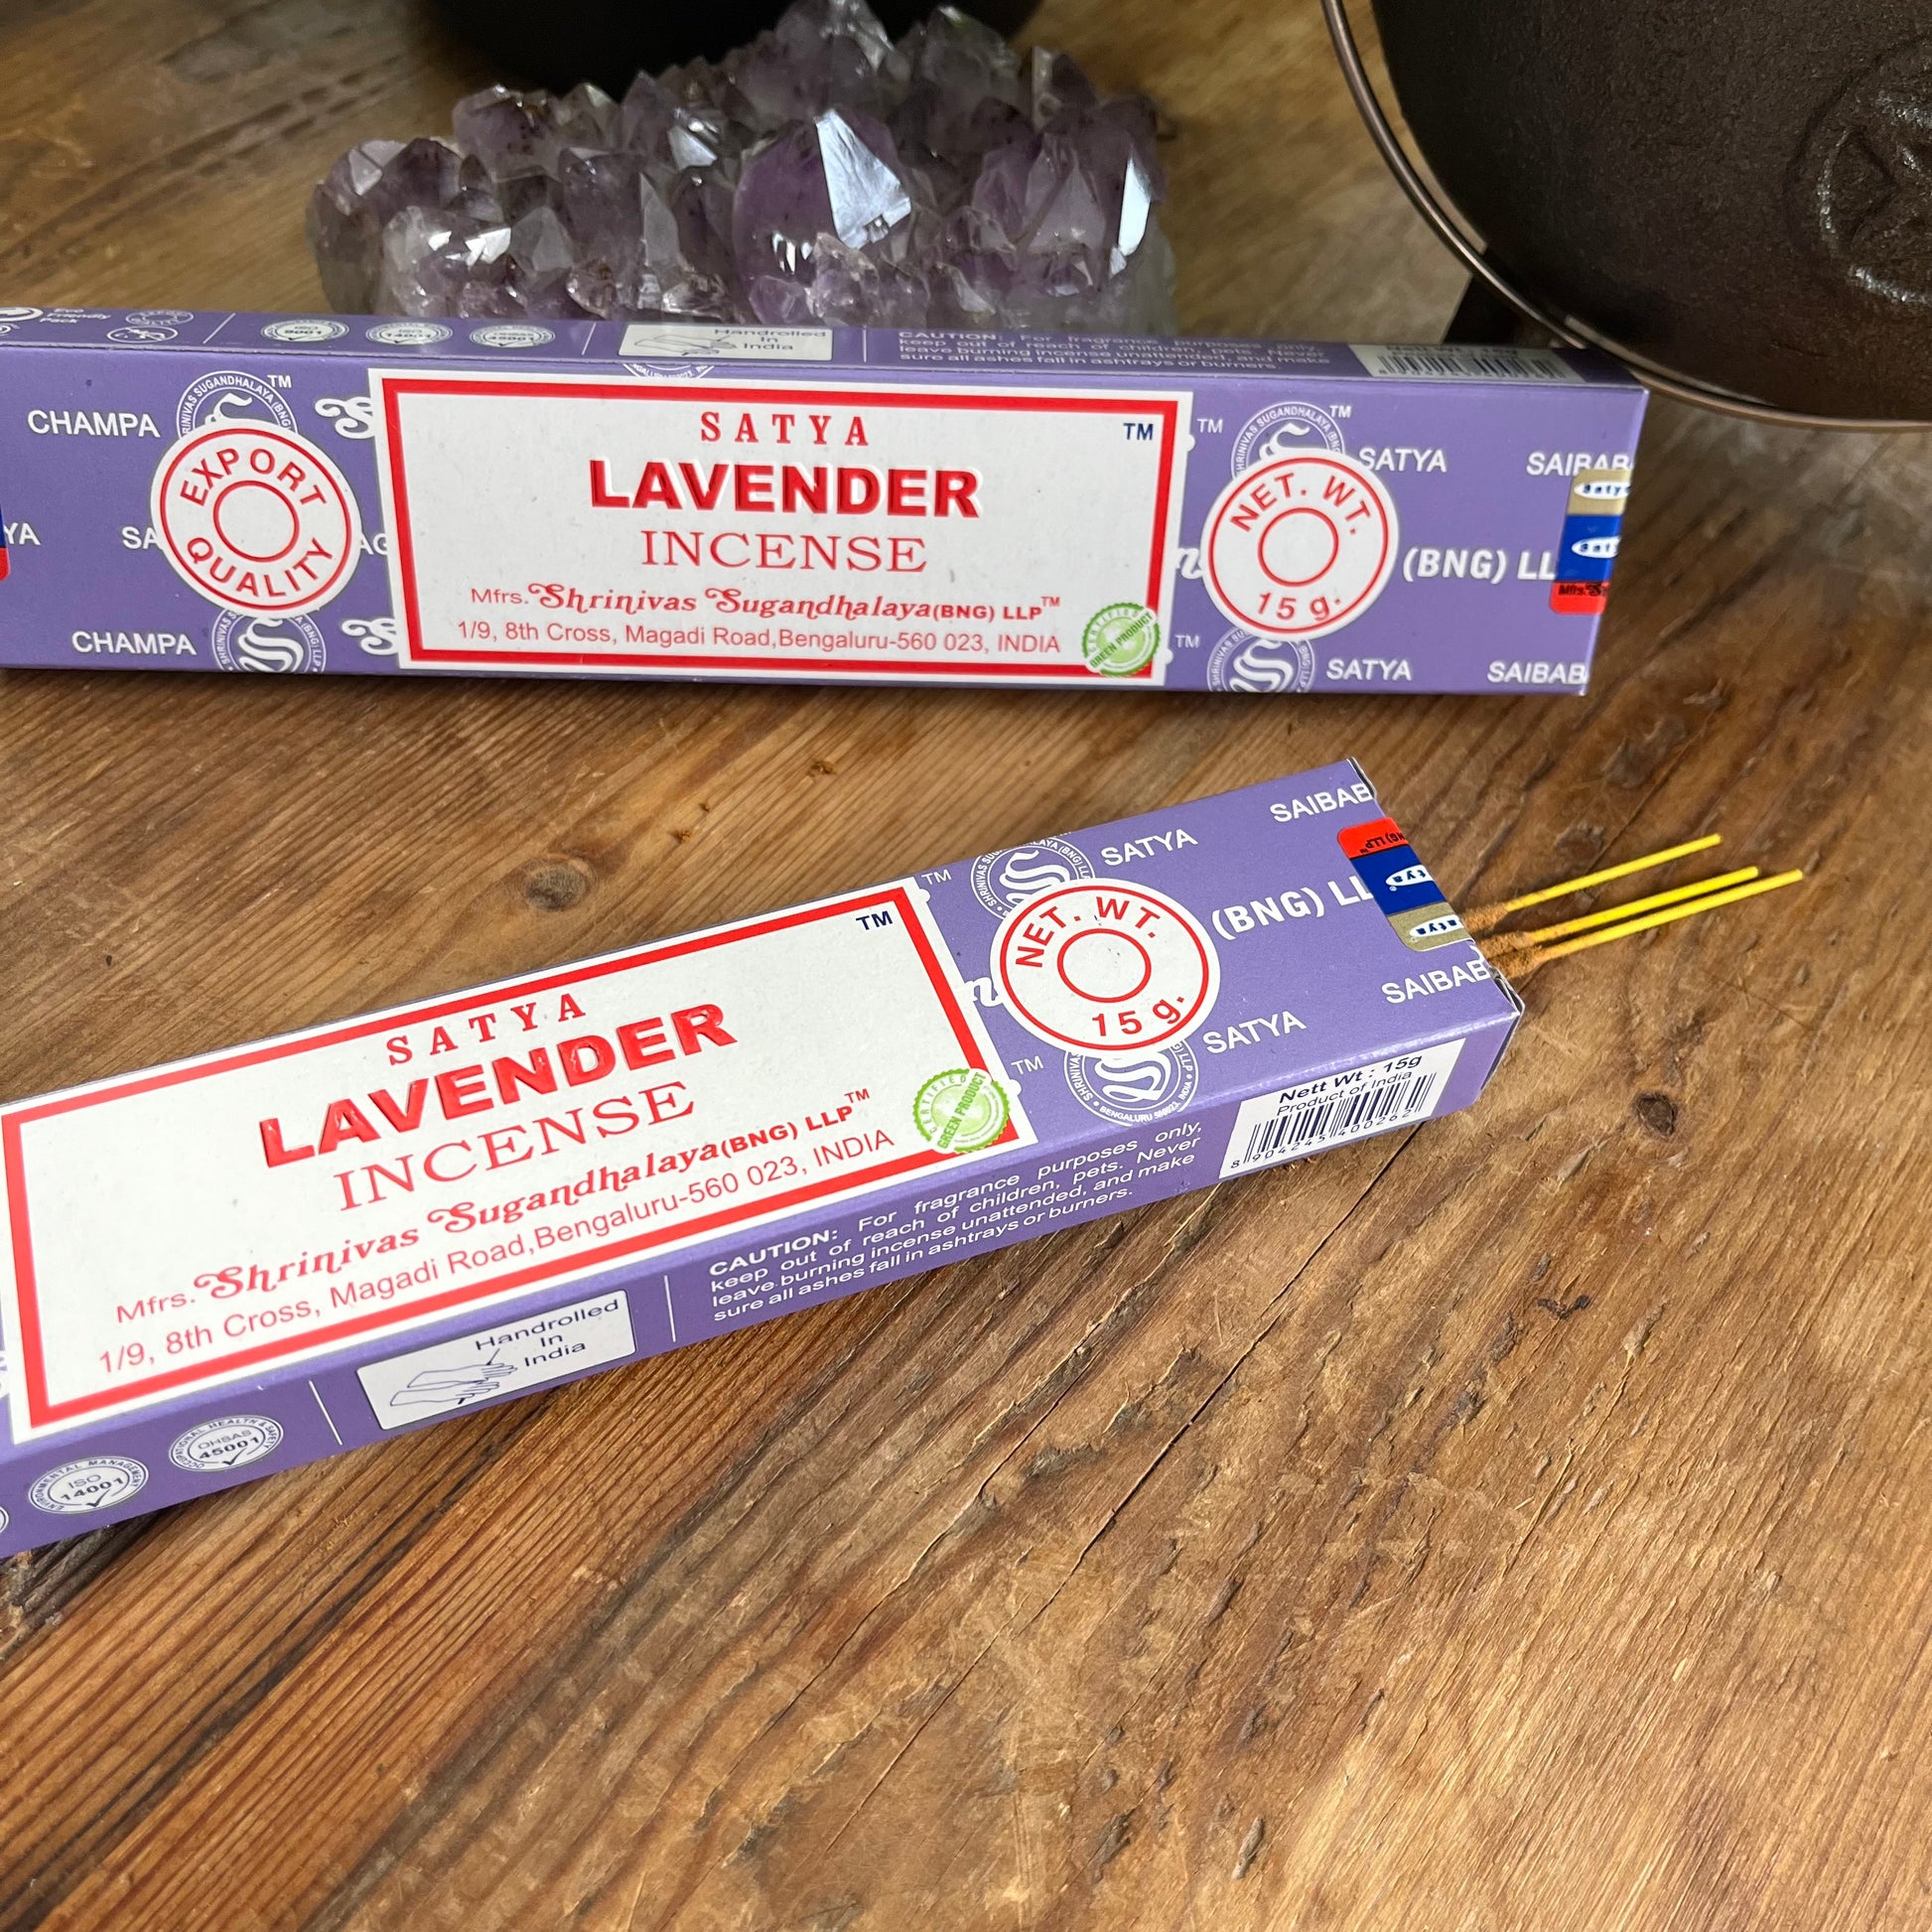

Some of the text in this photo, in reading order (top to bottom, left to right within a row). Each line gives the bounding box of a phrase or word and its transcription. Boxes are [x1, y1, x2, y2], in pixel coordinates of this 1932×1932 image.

[715, 329, 826, 338] Handrolled
[898, 339, 946, 347] keep
[1068, 336, 1159, 345] fragrance
[974, 354, 1033, 363] ashes
[1037, 355, 1066, 364] fall
[1090, 356, 1174, 367] ashtrays
[1035, 348, 1112, 357] incense
[194, 375, 274, 404] SUGANDHALAYA
[267, 374, 292, 388] TM
[28, 410, 160, 438] CHAMPA
[1197, 419, 1223, 433] TM
[1256, 406, 1331, 434] SUGANDHALAYA
[1329, 404, 1351, 418] TM
[700, 410, 869, 446] SATYA
[1123, 423, 1154, 441] TM
[1358, 449, 1447, 474] SATYA
[180, 447, 328, 507] EXPORT
[589, 459, 981, 518] LAVENDER
[1230, 473, 1373, 536] NET. WT.
[641, 530, 928, 573] INCENSE
[1402, 548, 1506, 584] (BNG)
[187, 537, 334, 598] QUALITY
[471, 589, 528, 605] Mfrs.
[528, 583, 697, 614] Shrinivas
[71, 630, 198, 655] CHAMPA
[457, 621, 497, 641] 1/9,
[505, 622, 538, 640] 8th
[547, 623, 618, 645] Cross,
[625, 625, 705, 648] Magadi
[944, 633, 989, 653] 023,
[997, 634, 1060, 653] INDIA
[1175, 635, 1199, 648] TM
[1326, 659, 1413, 682] SATYA
[1101, 828, 1199, 866] SATYA
[921, 869, 952, 887] TM
[975, 864, 998, 907] SHRINIVAS
[856, 910, 893, 930] TM
[1211, 886, 1325, 940] (BNG)
[1016, 896, 1162, 969] NET. WT.
[385, 993, 586, 1066] SATYA
[1092, 1010, 1144, 1037] 15
[1202, 1010, 1308, 1054] SATYA
[1011, 1055, 1043, 1075] TM
[1178, 1052, 1193, 1072] LLP
[259, 1004, 738, 1169] LAVENDER
[1276, 1071, 1413, 1116] Product of India
[1279, 1079, 1327, 1104] Nett
[1384, 1054, 1424, 1073] 15g
[919, 1074, 967, 1134] CERTIFIED
[937, 1116, 962, 1149] GREEN
[954, 1071, 987, 1116] PRODUCT
[1099, 1105, 1154, 1123] BENGALURU
[334, 1080, 694, 1211] INCENSE
[709, 1122, 1202, 1277] CAUTION: For fragrance purposes only,
[711, 1137, 1201, 1293] keep out of reach of children, pets. Never
[712, 1154, 1195, 1308] leave burning incense unattended, and make
[99, 1341, 155, 1374] 1/9,
[165, 1323, 212, 1355] 8th
[223, 1301, 322, 1337] Cross,
[331, 1259, 439, 1308] Magadi
[747, 1156, 808, 1186] 023,
[813, 1129, 895, 1167] INDIA
[714, 1190, 1133, 1322] sure all ashes fall in ashtrays or burners.
[116, 1291, 197, 1323] Mfrs.
[194, 1228, 420, 1300] Shrinivas
[475, 1299, 620, 1350] Handrolled
[524, 1340, 587, 1367] India
[540, 1333, 563, 1347] In
[198, 1430, 252, 1449] OHSAS
[199, 1437, 259, 1459] 45001
[60, 1477, 124, 1501] 14001
[68, 1474, 101, 1489] ISO
